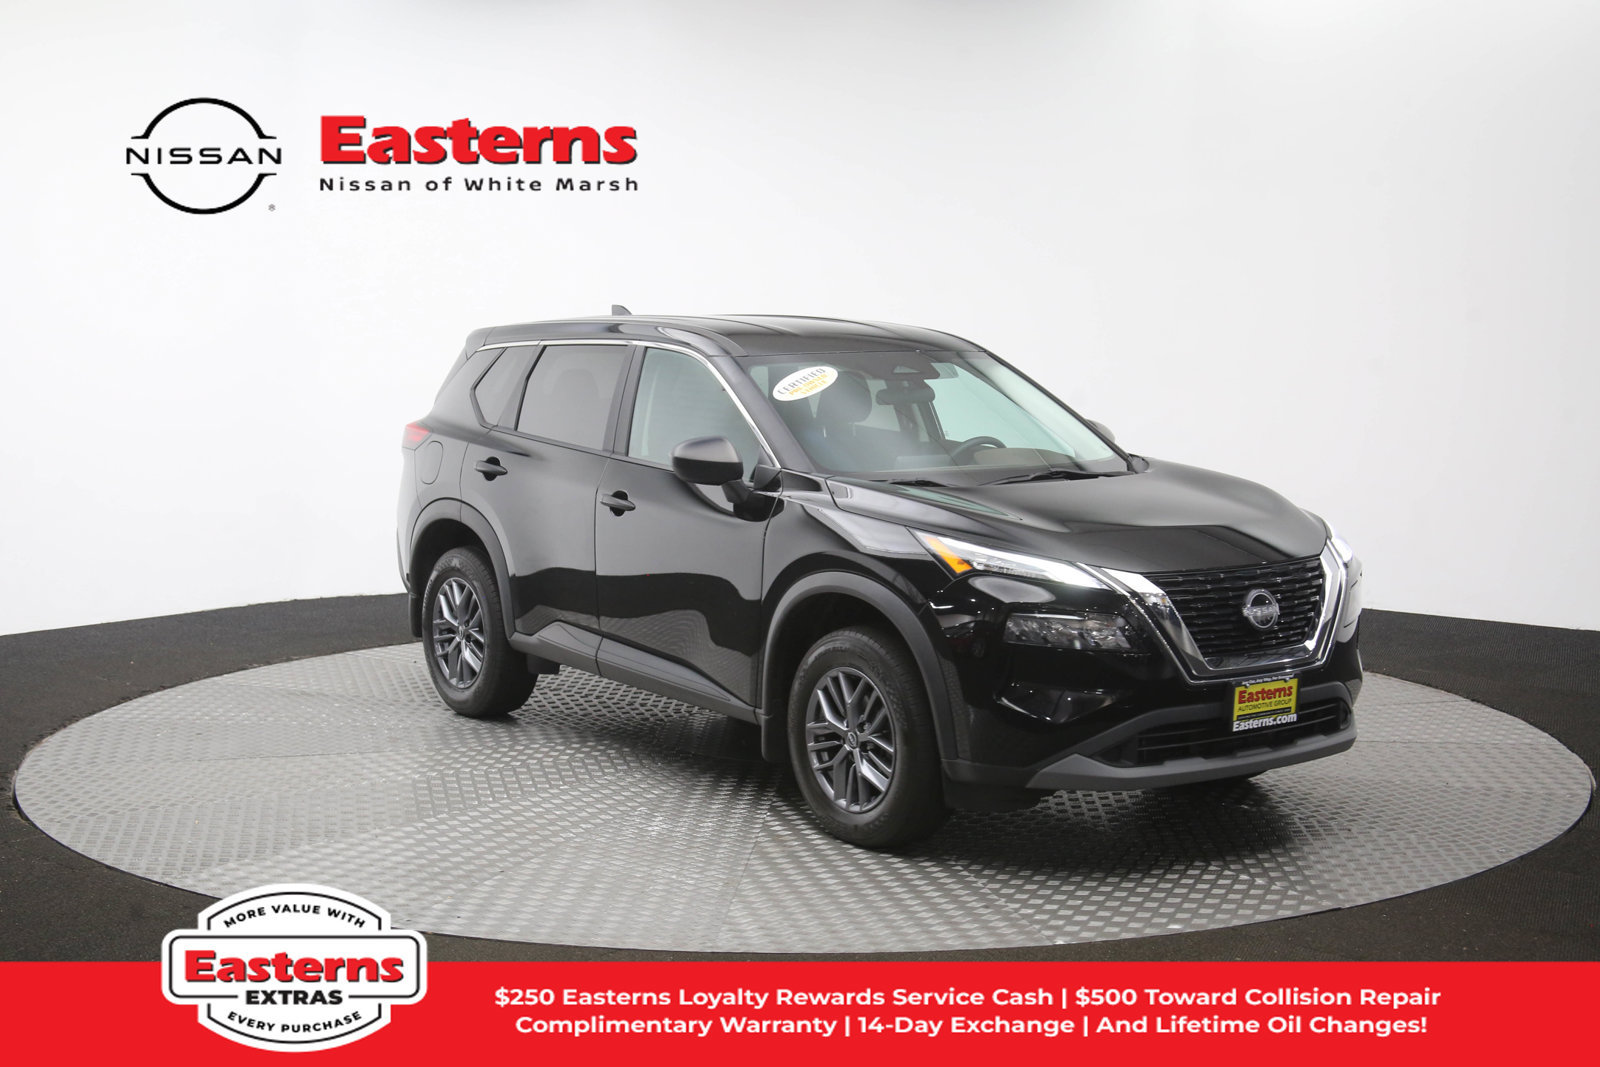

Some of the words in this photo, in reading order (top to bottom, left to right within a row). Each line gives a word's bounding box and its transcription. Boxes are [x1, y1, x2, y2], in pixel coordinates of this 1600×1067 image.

[777, 367, 826, 395] CERTIFIED
[1238, 686, 1293, 705] Easterns
[1238, 701, 1273, 712] AUTOMOTIVE
[1274, 698, 1292, 707] GROUP
[1232, 713, 1298, 732] Easterns.com
